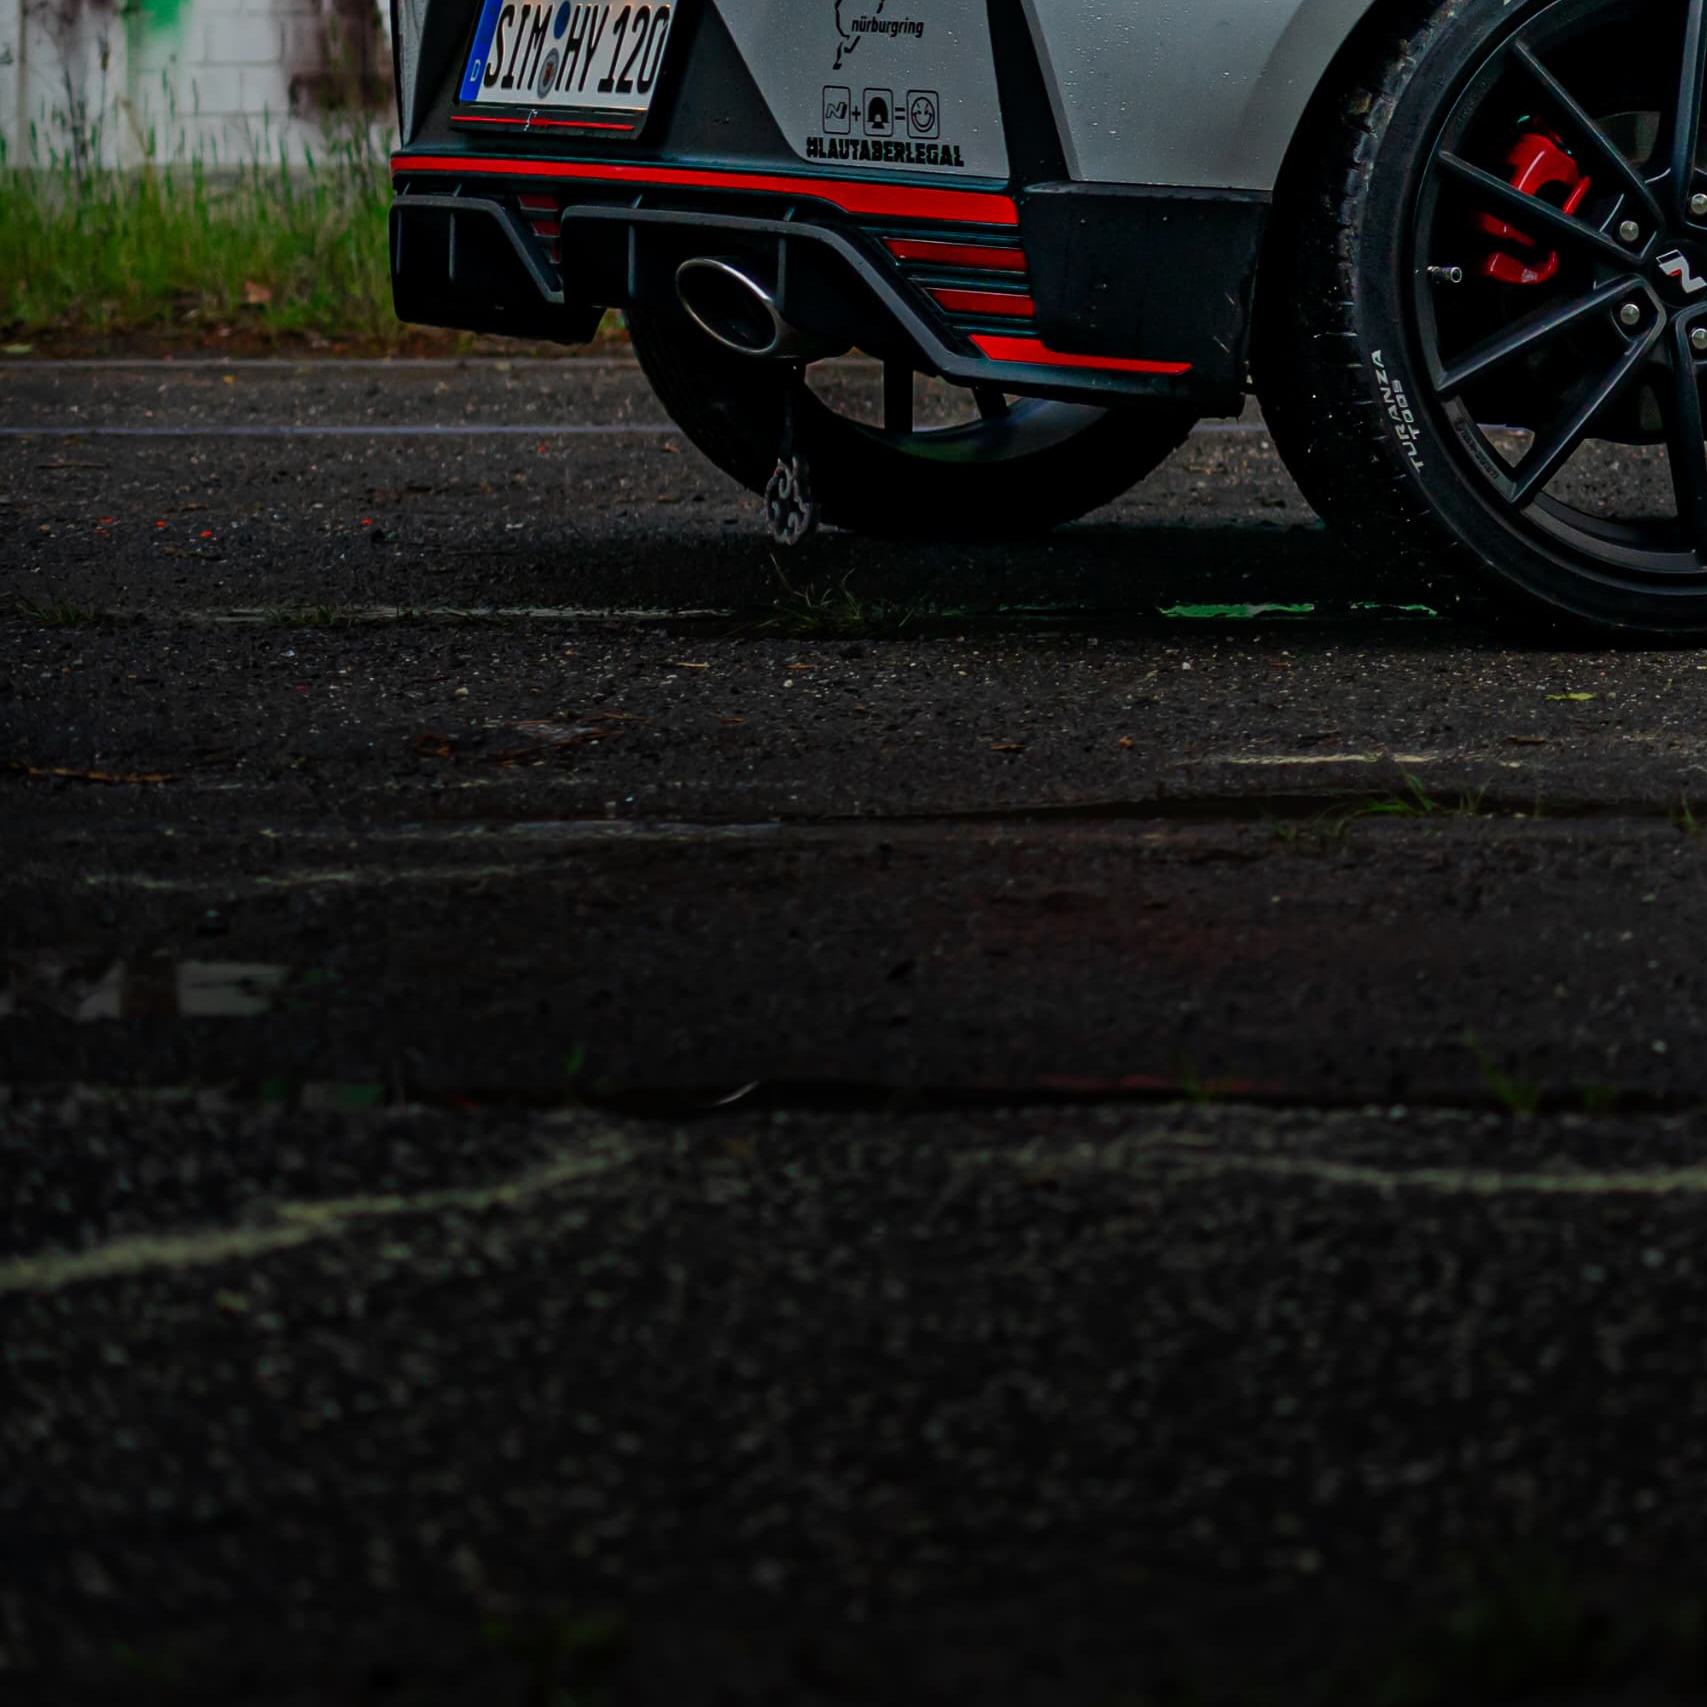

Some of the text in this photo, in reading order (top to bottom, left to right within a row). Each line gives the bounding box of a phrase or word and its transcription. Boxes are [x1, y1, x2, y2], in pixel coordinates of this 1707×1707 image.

[469, 4, 671, 94] D SIM HY 120
[851, 16, 924, 39] nürburgring
[806, 136, 965, 168] #LAUTABERLEGAL
[1371, 349, 1425, 475] TURANZA
